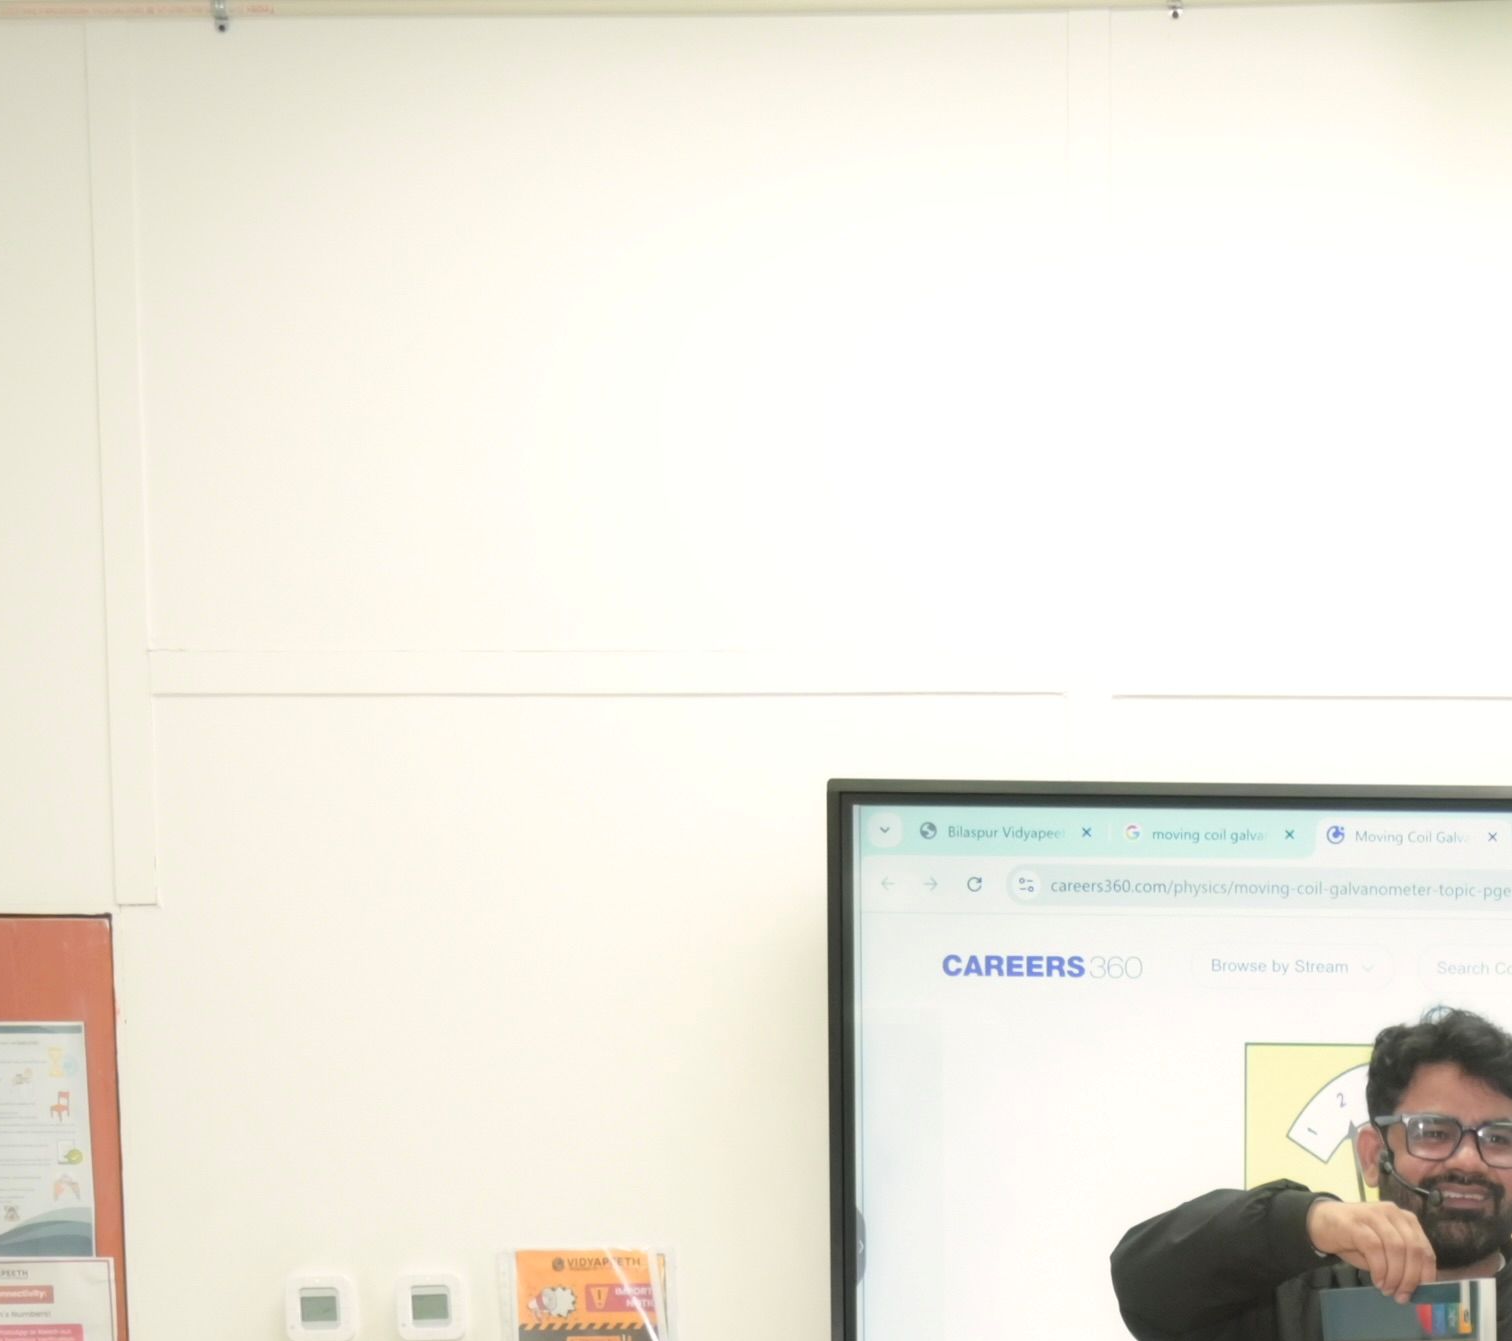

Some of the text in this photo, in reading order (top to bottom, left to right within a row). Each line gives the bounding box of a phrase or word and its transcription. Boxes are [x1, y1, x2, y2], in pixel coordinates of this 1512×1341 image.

[948, 825, 998, 840] Bilaspur
[1152, 828, 1266, 843] moving coil galva
[1355, 830, 1471, 845] Moving Coil Galv
[1050, 878, 1512, 902] careers360.com/physics/moving-coil-galvanometer-topic-pge
[1210, 958, 1349, 976] Browse by Stream
[1437, 960, 1490, 976] Search
[1336, 1091, 1347, 1109] 2
